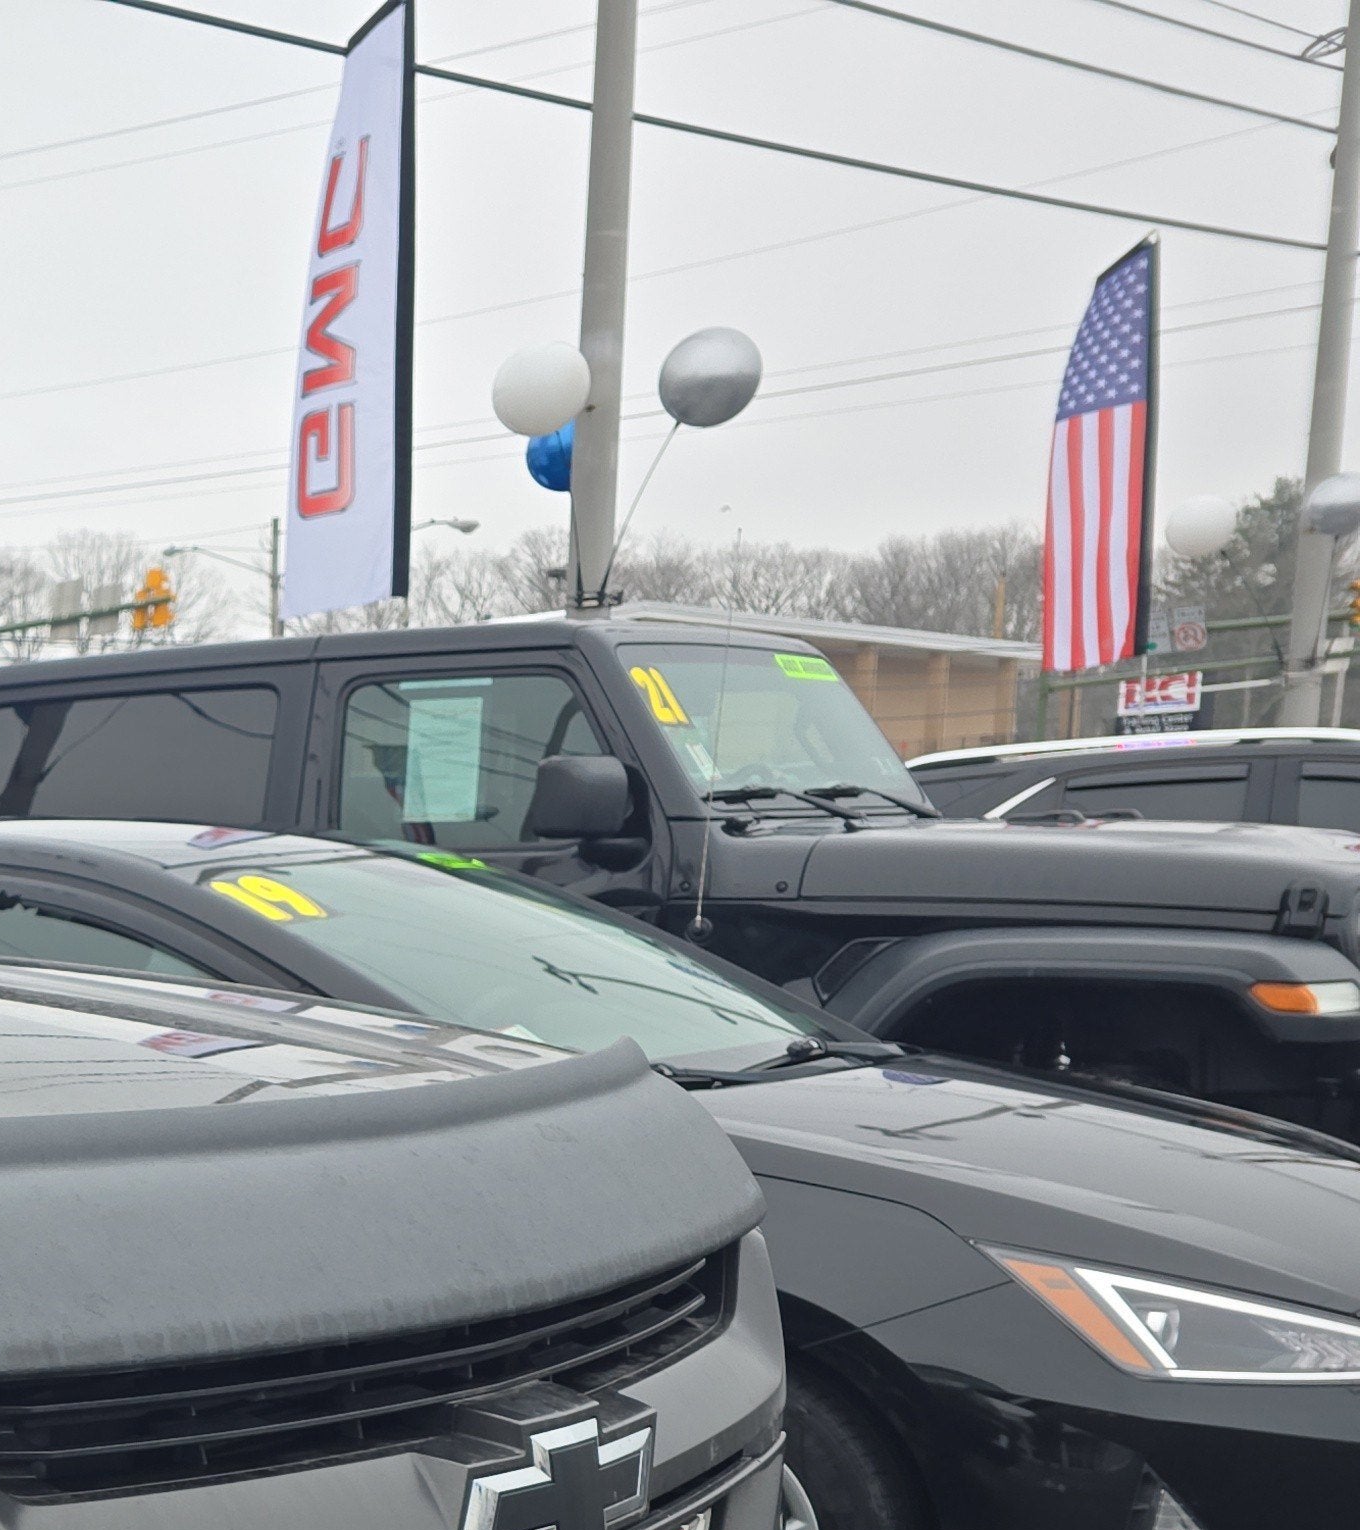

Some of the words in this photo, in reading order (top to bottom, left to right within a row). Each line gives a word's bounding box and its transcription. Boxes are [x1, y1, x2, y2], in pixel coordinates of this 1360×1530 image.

[299, 135, 371, 519] GMC
[629, 666, 689, 724] 21
[210, 875, 328, 920] 19
